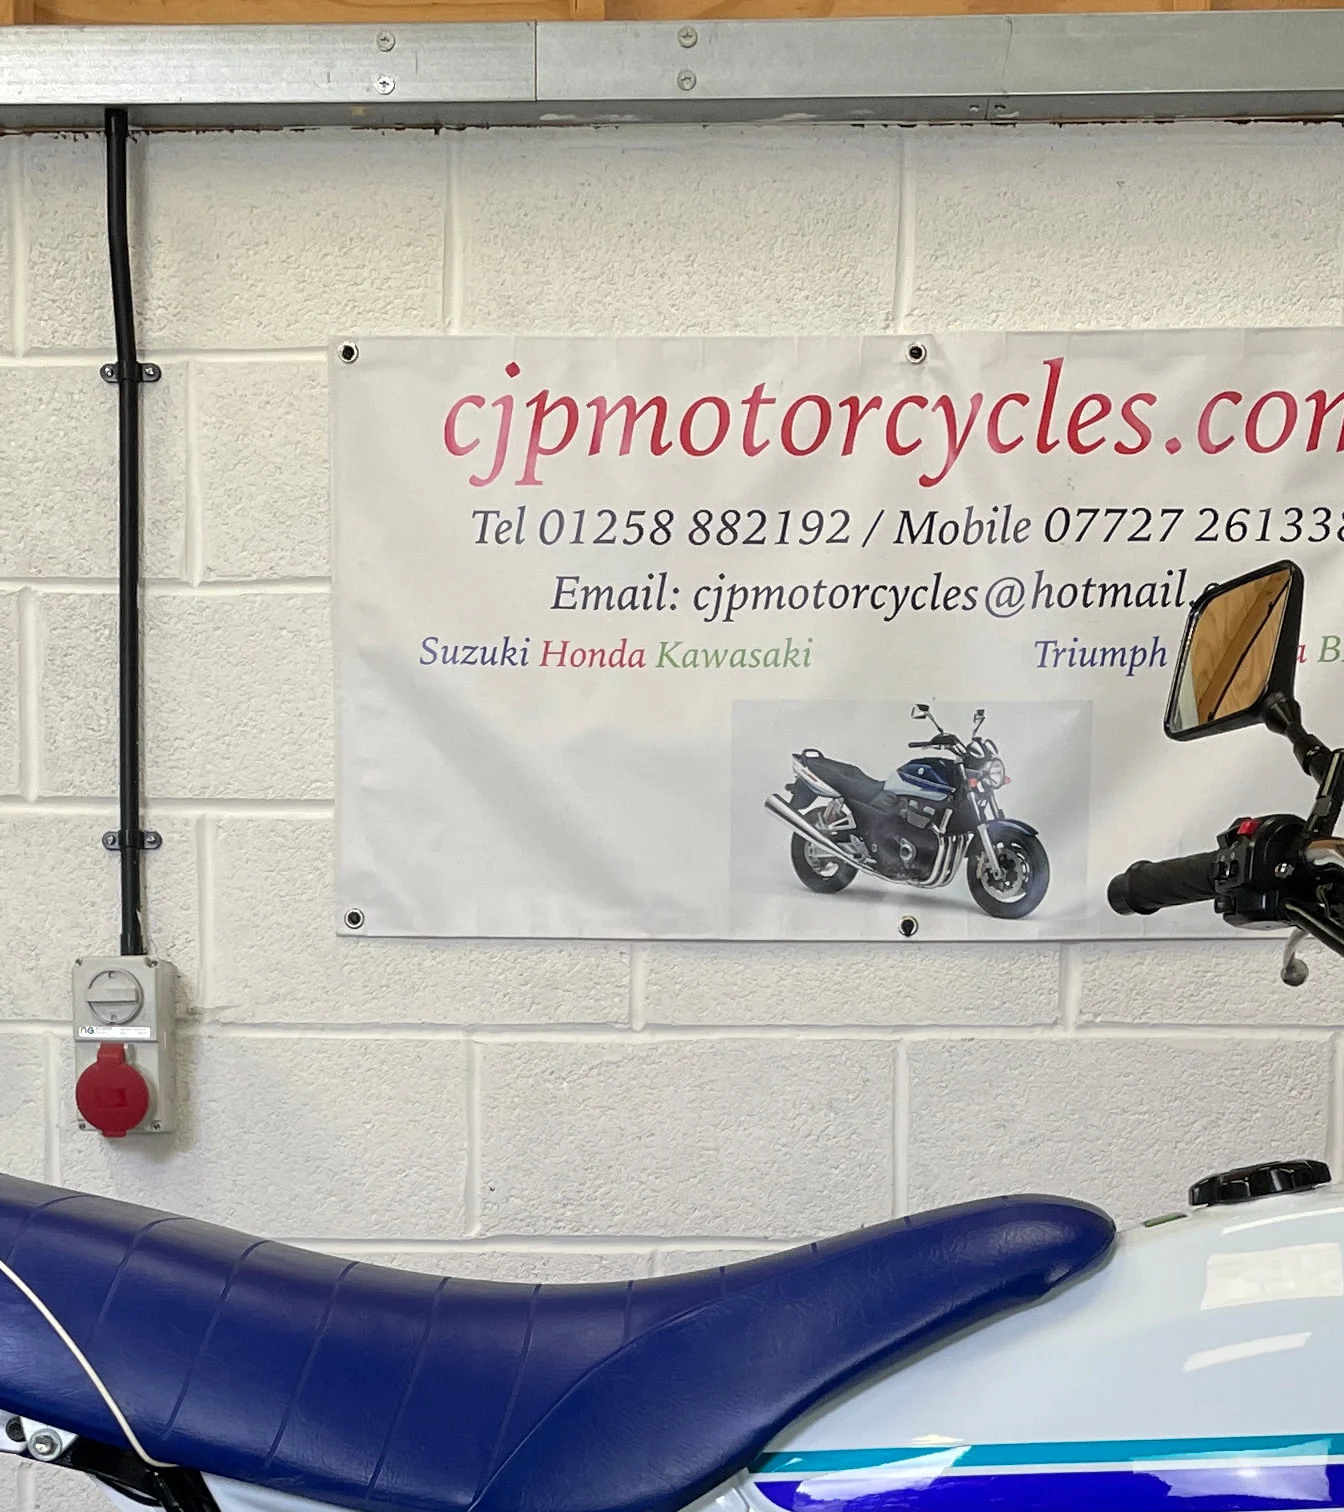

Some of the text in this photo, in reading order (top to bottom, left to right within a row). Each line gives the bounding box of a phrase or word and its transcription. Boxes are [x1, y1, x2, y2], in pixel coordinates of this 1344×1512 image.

[471, 505, 527, 545] Tel
[538, 508, 675, 546] 01258
[687, 508, 852, 546] 882192
[861, 508, 886, 548] /
[892, 504, 1032, 546] Mobile
[1043, 506, 1185, 544] 07727
[549, 567, 1220, 624] Email: cjpmotorcycles@hotmail.
[418, 635, 816, 669] Suzuki Honda Kawasaki
[1033, 635, 1169, 678] Triumph
